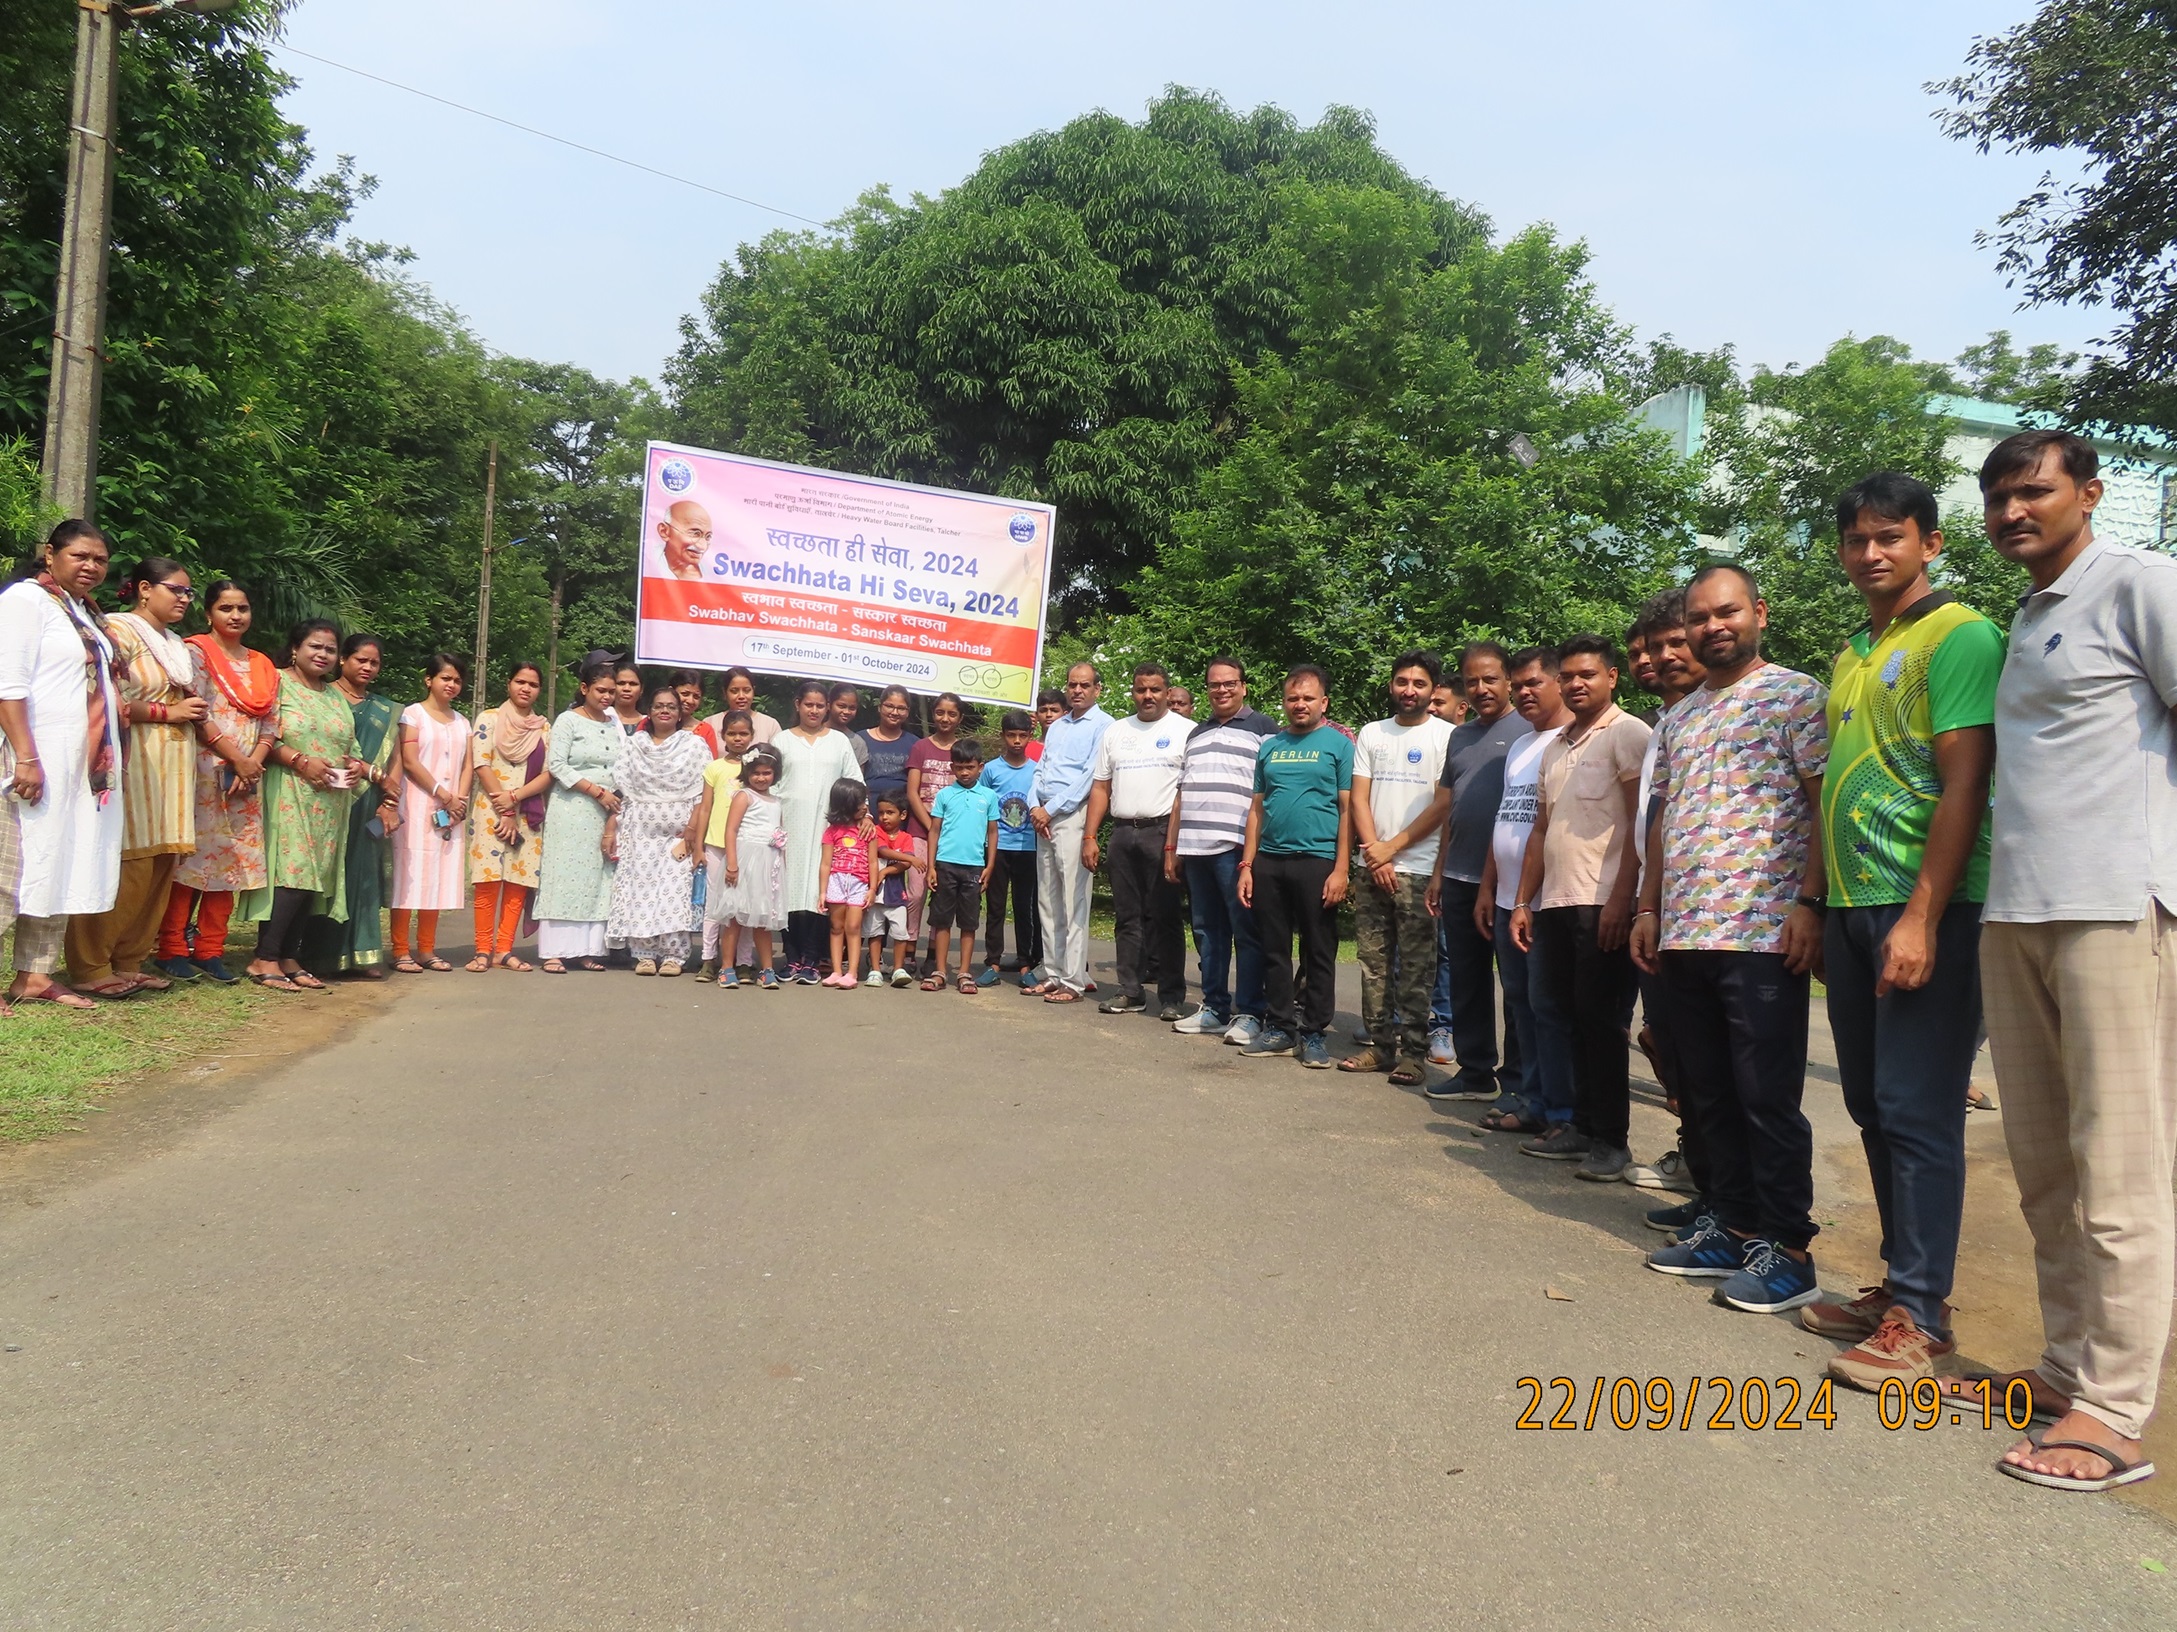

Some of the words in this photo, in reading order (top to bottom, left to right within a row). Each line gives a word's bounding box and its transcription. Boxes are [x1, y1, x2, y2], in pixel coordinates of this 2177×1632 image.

[837, 502, 876, 514] Department
[885, 510, 908, 519] Atomic
[910, 513, 934, 524] Energy
[893, 501, 910, 510] India
[841, 512, 862, 522] Heavy
[863, 516, 882, 525] Water
[883, 519, 904, 528] Board
[937, 527, 961, 537] Talcher
[766, 527, 840, 558] स्वच्छता
[845, 533, 865, 562] ही
[871, 537, 915, 571] सेवा,
[922, 551, 978, 578] 2024
[713, 552, 851, 592] Swachhata
[860, 573, 884, 597] Hi
[893, 579, 956, 614] Seva,
[963, 590, 1019, 618] 2024
[741, 592, 786, 609] स्वभाव
[789, 597, 838, 615] स्वच्छता
[852, 602, 898, 624] संस्कार
[901, 613, 947, 633] स्वच्छता
[688, 605, 755, 623] Swabhav
[758, 611, 838, 632] Swachhata
[851, 623, 916, 645] Sanskaar
[919, 634, 992, 656] Swachhata
[772, 643, 832, 660] September
[862, 655, 904, 672] October
[906, 662, 931, 676] 2024
[1271, 750, 1320, 759] BERLIN
